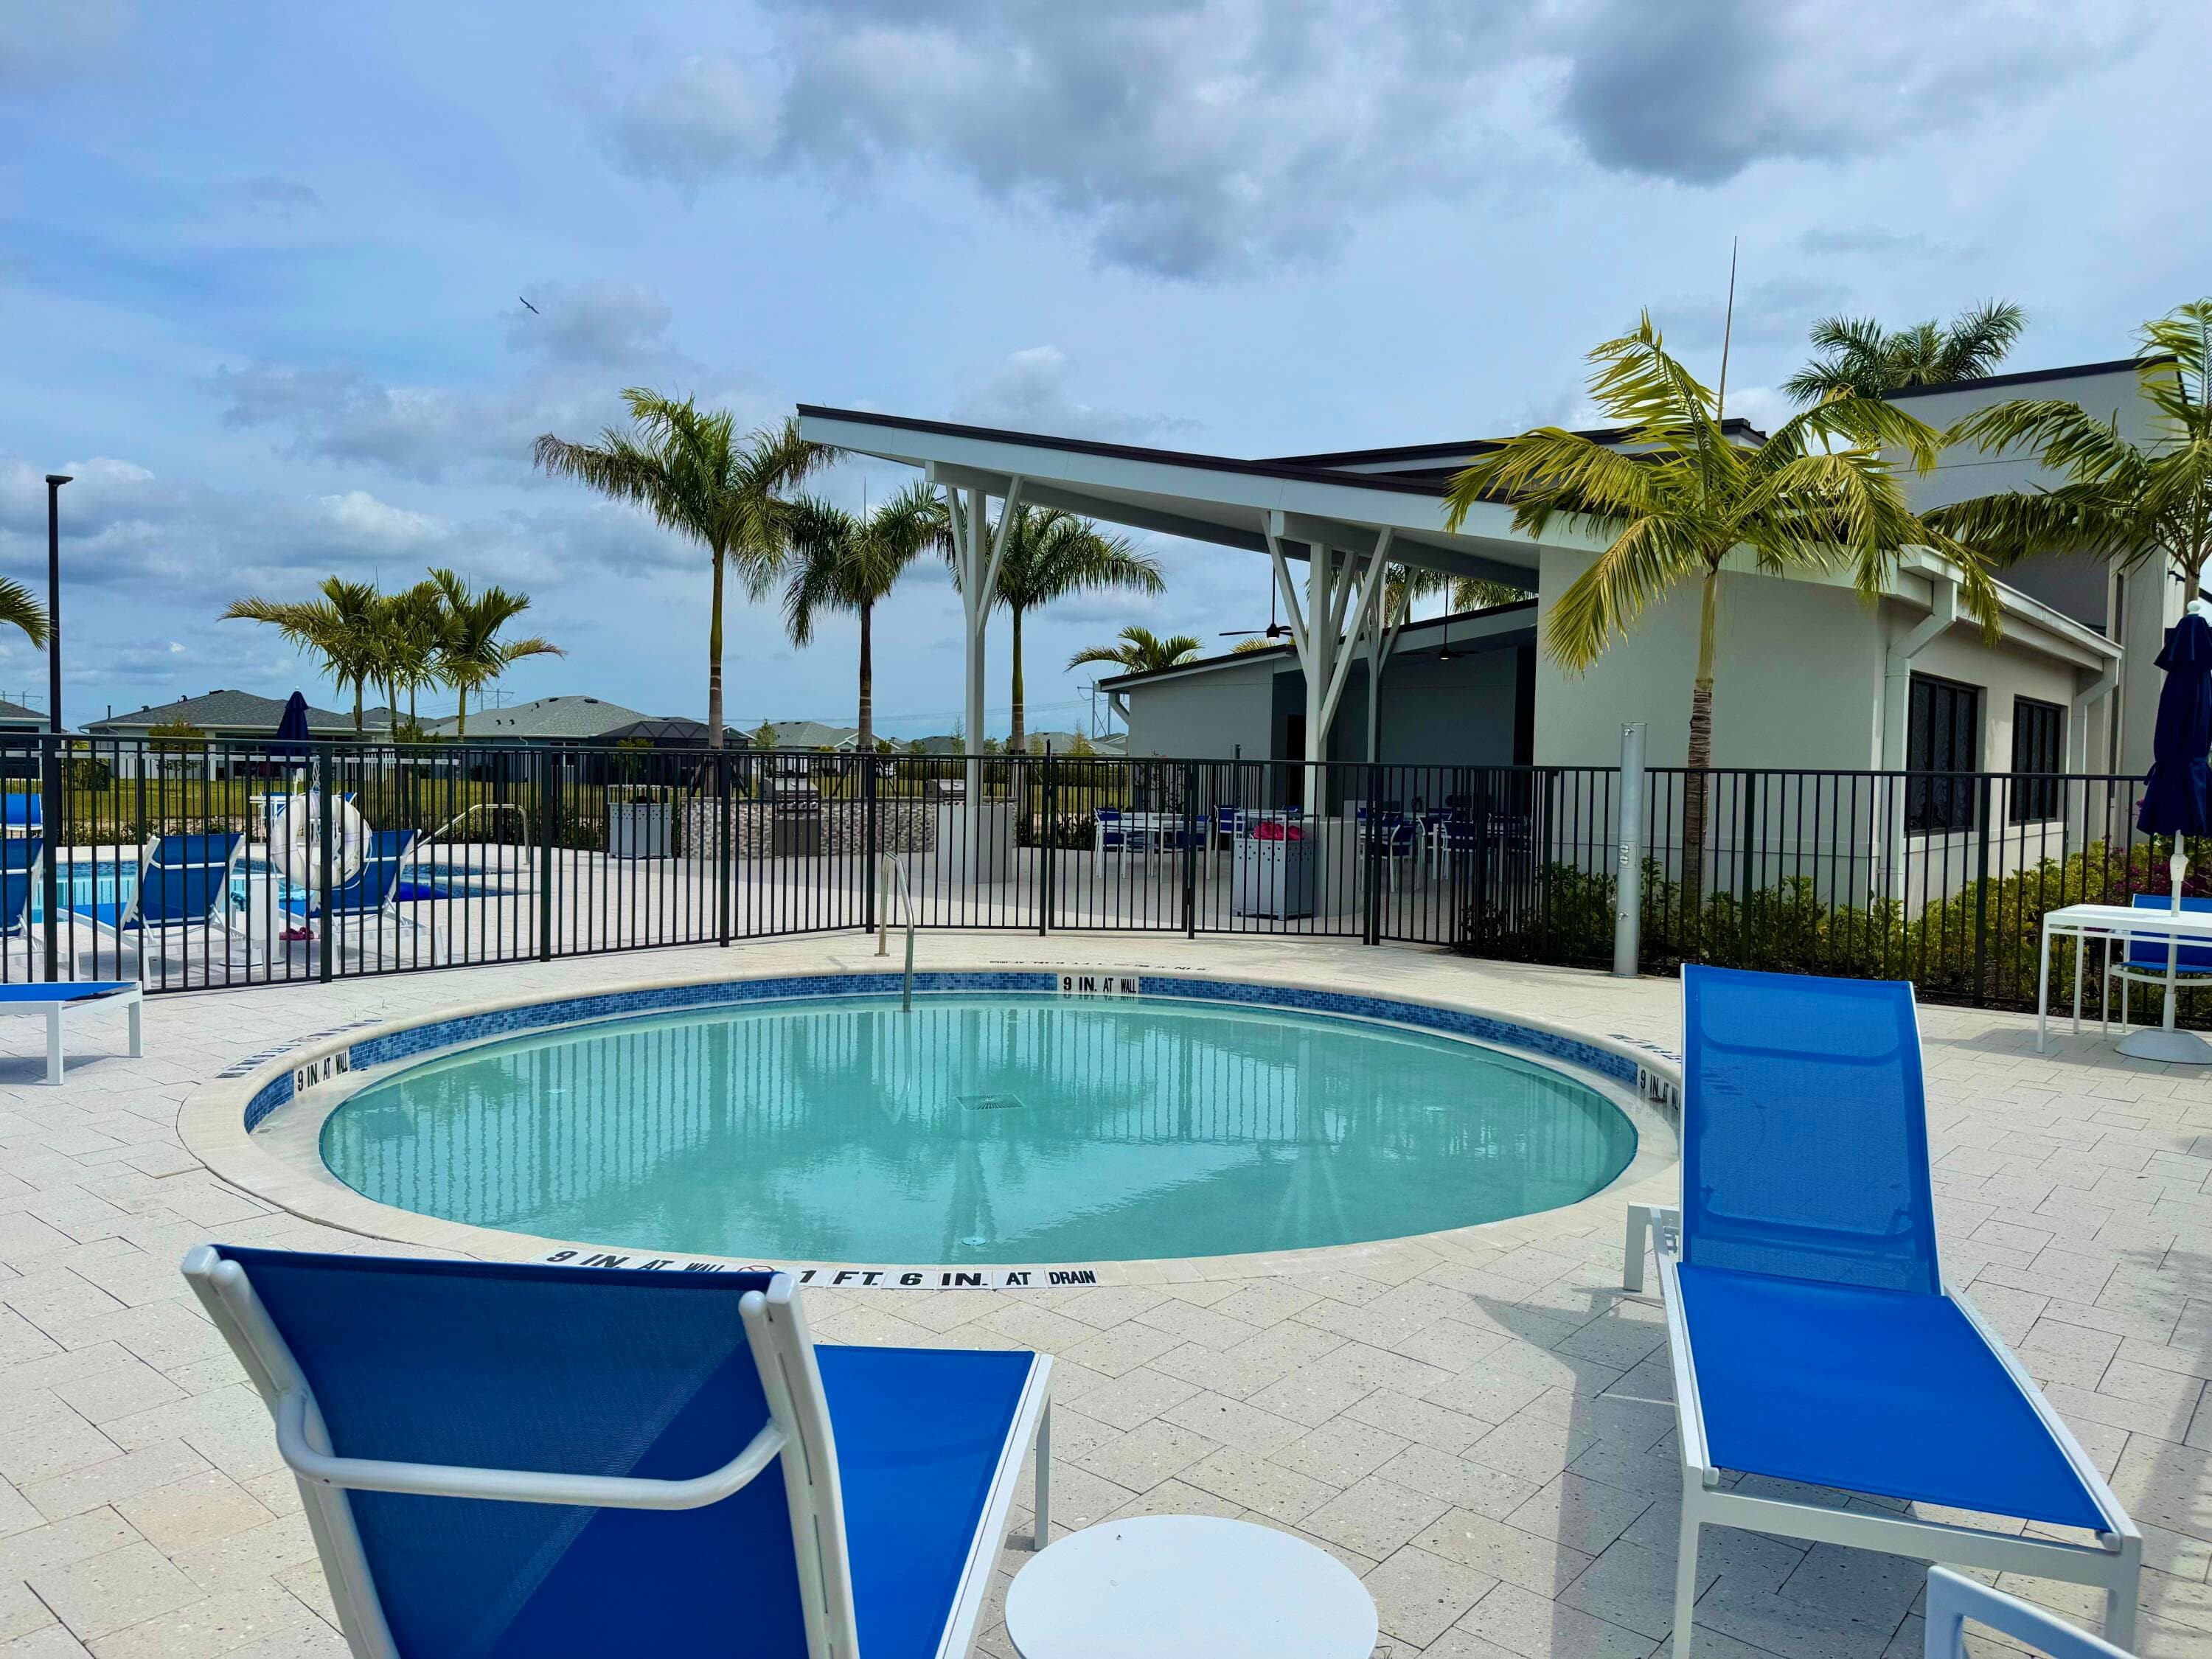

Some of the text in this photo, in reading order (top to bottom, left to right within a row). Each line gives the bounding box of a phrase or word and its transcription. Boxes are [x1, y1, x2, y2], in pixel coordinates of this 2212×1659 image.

[1063, 976, 1137, 993] 9 IN. AT WALL
[297, 1051, 348, 1091] 9 IN. AT WALL
[1640, 1069, 1646, 1089] 9
[546, 1251, 579, 1262] 9
[579, 1254, 630, 1269] IN.
[638, 1259, 675, 1270] AT
[799, 1270, 1096, 1286] 1 FT. 6 IN. AT DRAIN
